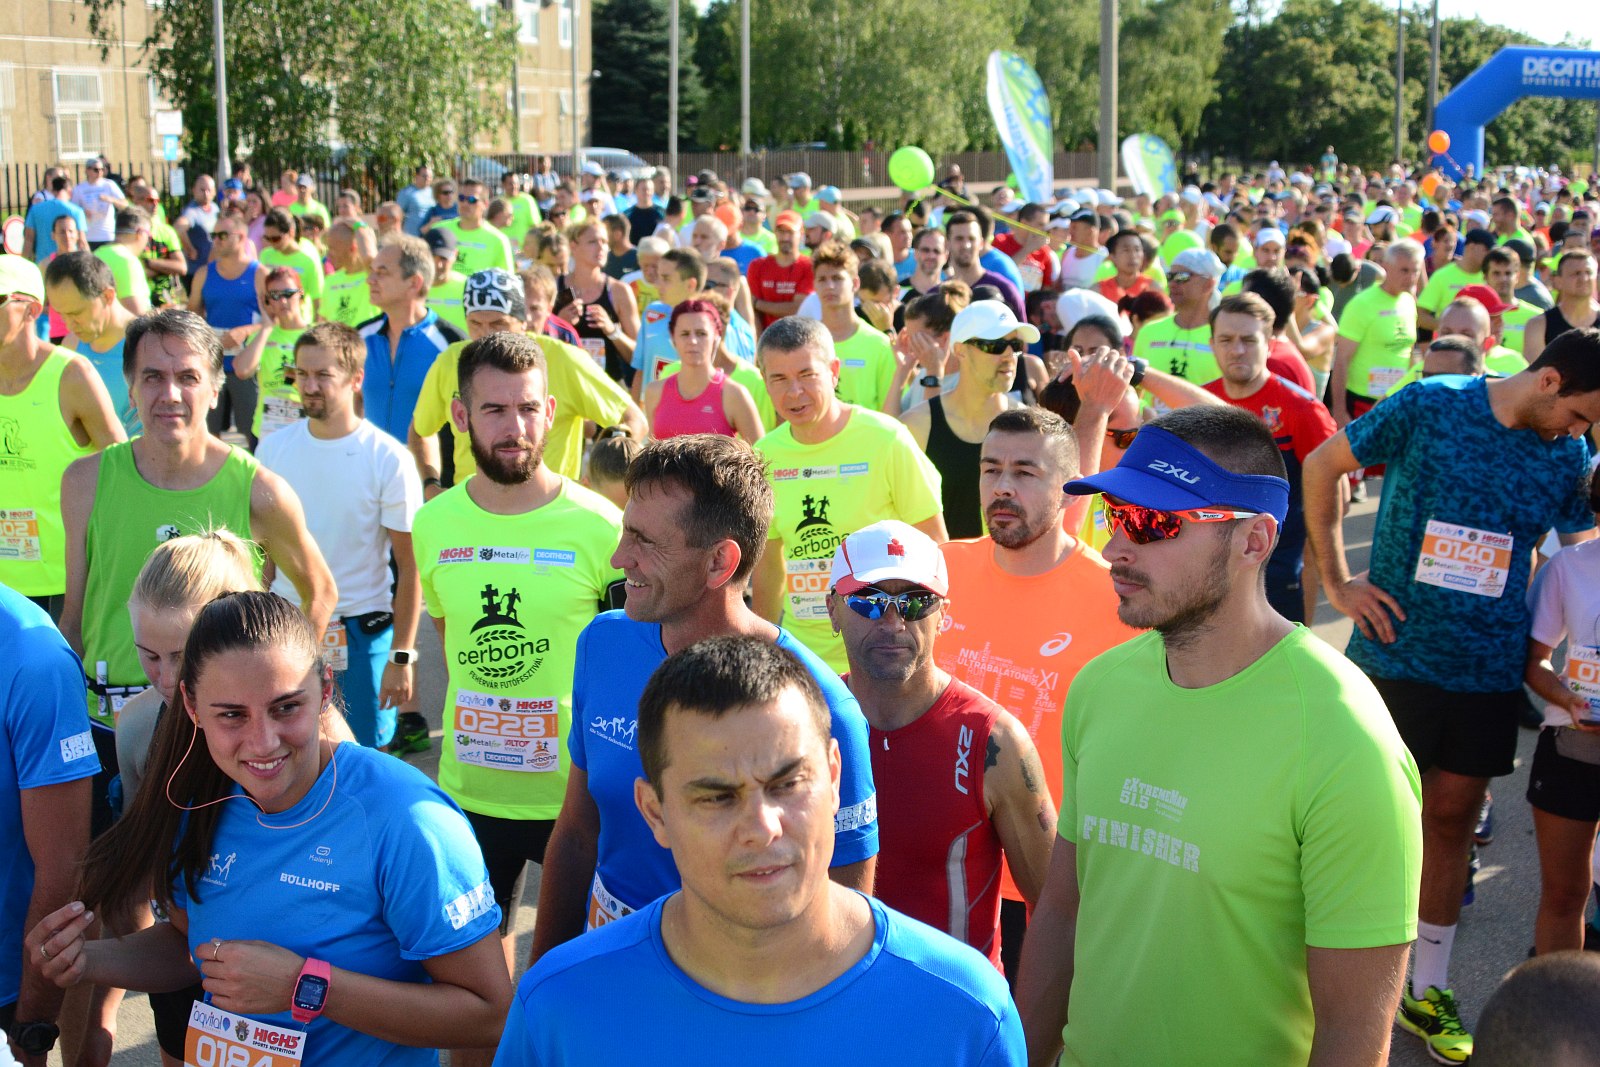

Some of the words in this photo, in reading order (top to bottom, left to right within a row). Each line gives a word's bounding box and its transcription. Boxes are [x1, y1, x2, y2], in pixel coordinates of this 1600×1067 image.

[1523, 56, 1600, 77] DECATH
[1147, 459, 1201, 485] 2XU
[0, 521, 28, 537] 02
[438, 547, 474, 560] HIGH5
[493, 551, 530, 560] Metalfer
[536, 551, 574, 561] DECATHLON
[1434, 539, 1495, 566] 0140
[457, 638, 550, 665] cerbona
[959, 647, 979, 660] NN
[468, 671, 499, 689] FEHÉRVÁR
[500, 657, 544, 690] FUTÓFESZTIVÁL
[957, 656, 1031, 684] ULTRABALATON
[516, 701, 553, 709] HIGH5
[459, 709, 546, 738] 0228
[526, 754, 557, 764] cerbona
[955, 724, 974, 795] 2XU
[1082, 814, 1201, 874] FINISHER
[280, 872, 340, 893] BÖLLHOFF
[193, 1009, 223, 1030] aqvital
[252, 1040, 269, 1049] SPORTS
[269, 1044, 297, 1056] NUTRITION
[253, 1027, 300, 1050] HIGH5
